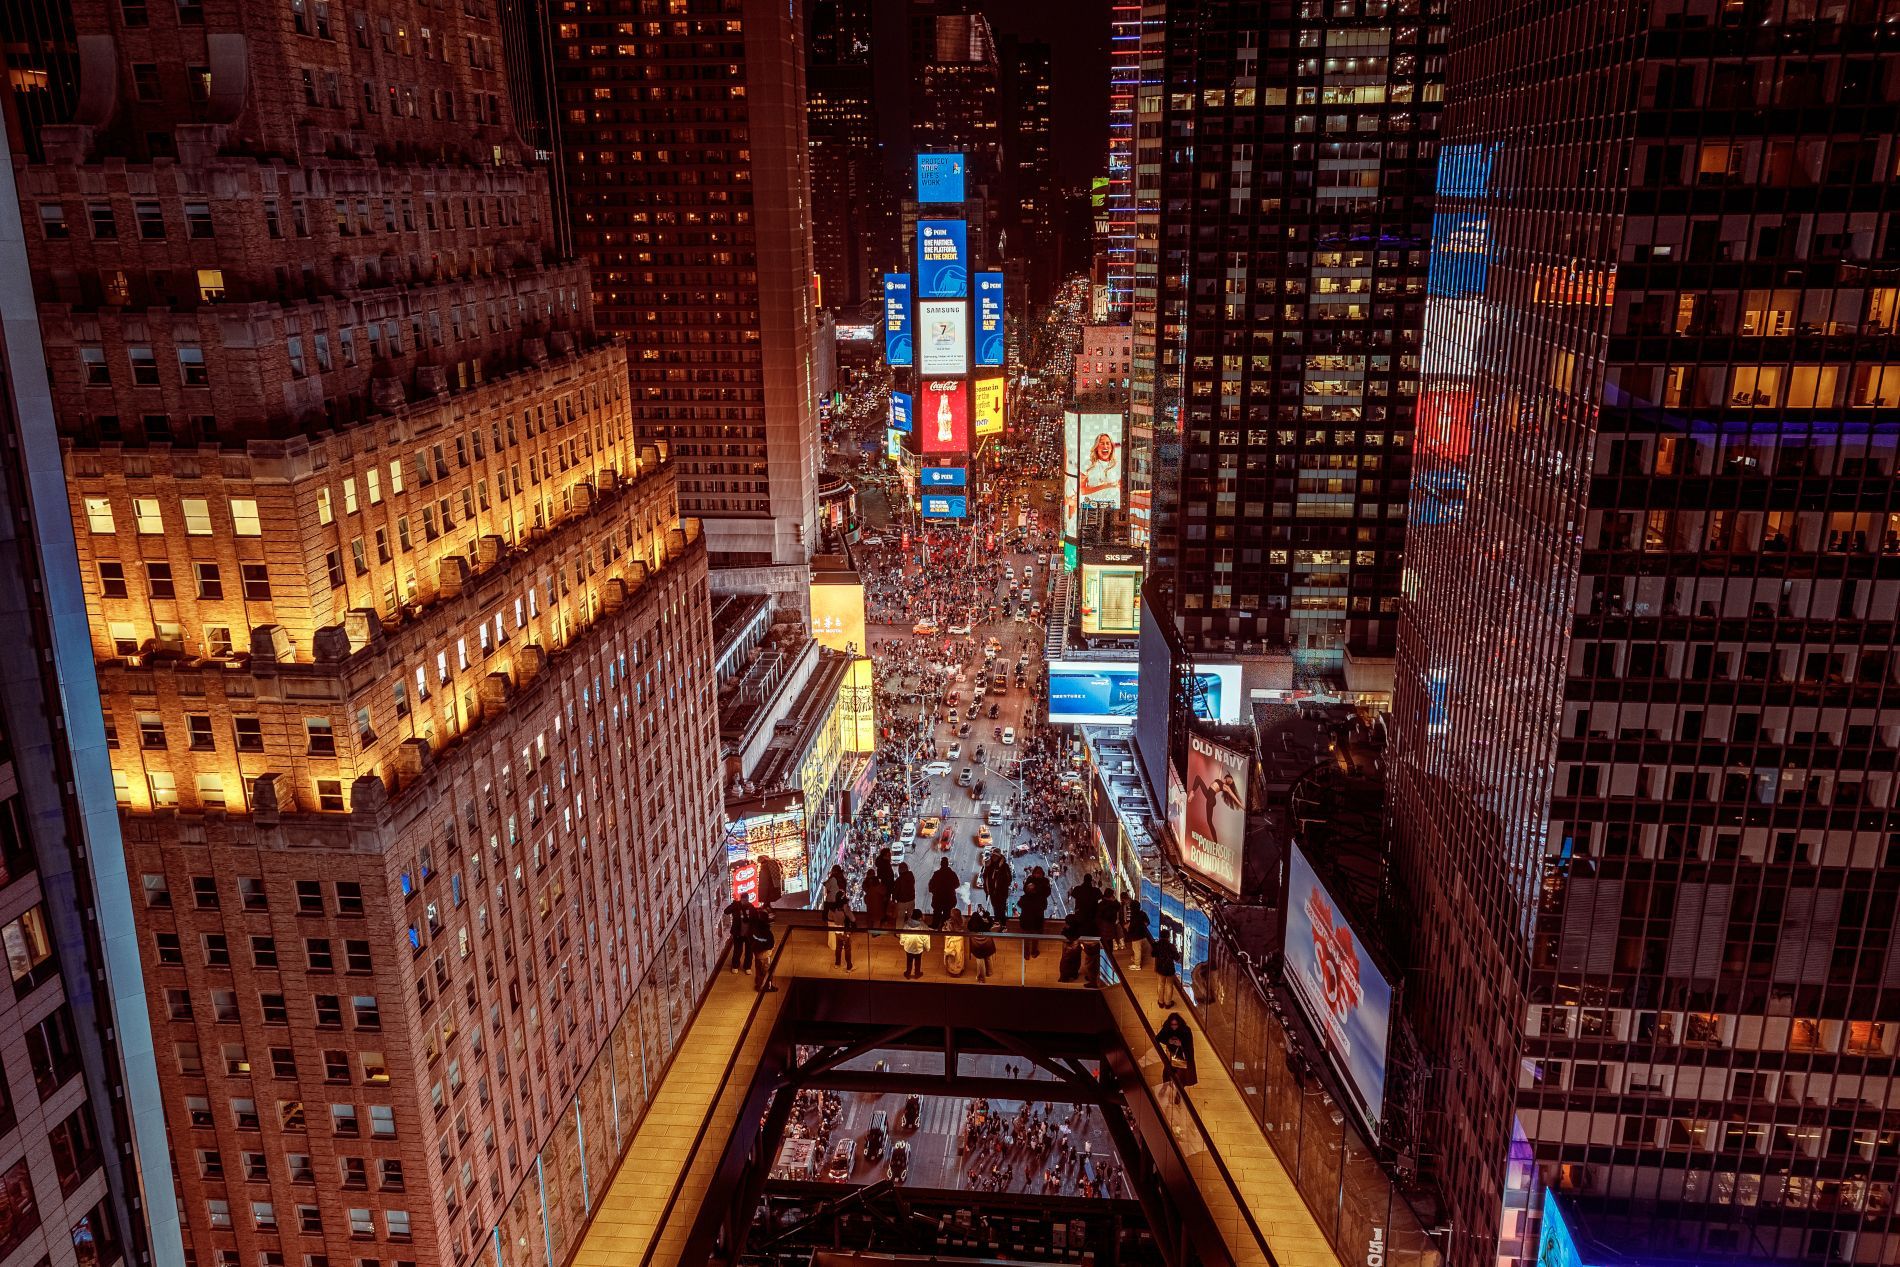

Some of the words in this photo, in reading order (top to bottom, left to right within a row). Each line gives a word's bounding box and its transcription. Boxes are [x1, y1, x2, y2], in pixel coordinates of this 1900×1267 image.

[939, 325, 947, 335] 7
[1192, 738, 1213, 757] OLD
[1215, 748, 1244, 771] NAVY
[1198, 834, 1235, 861] POWERSOFT
[1190, 845, 1234, 882] BOUNDLESS
